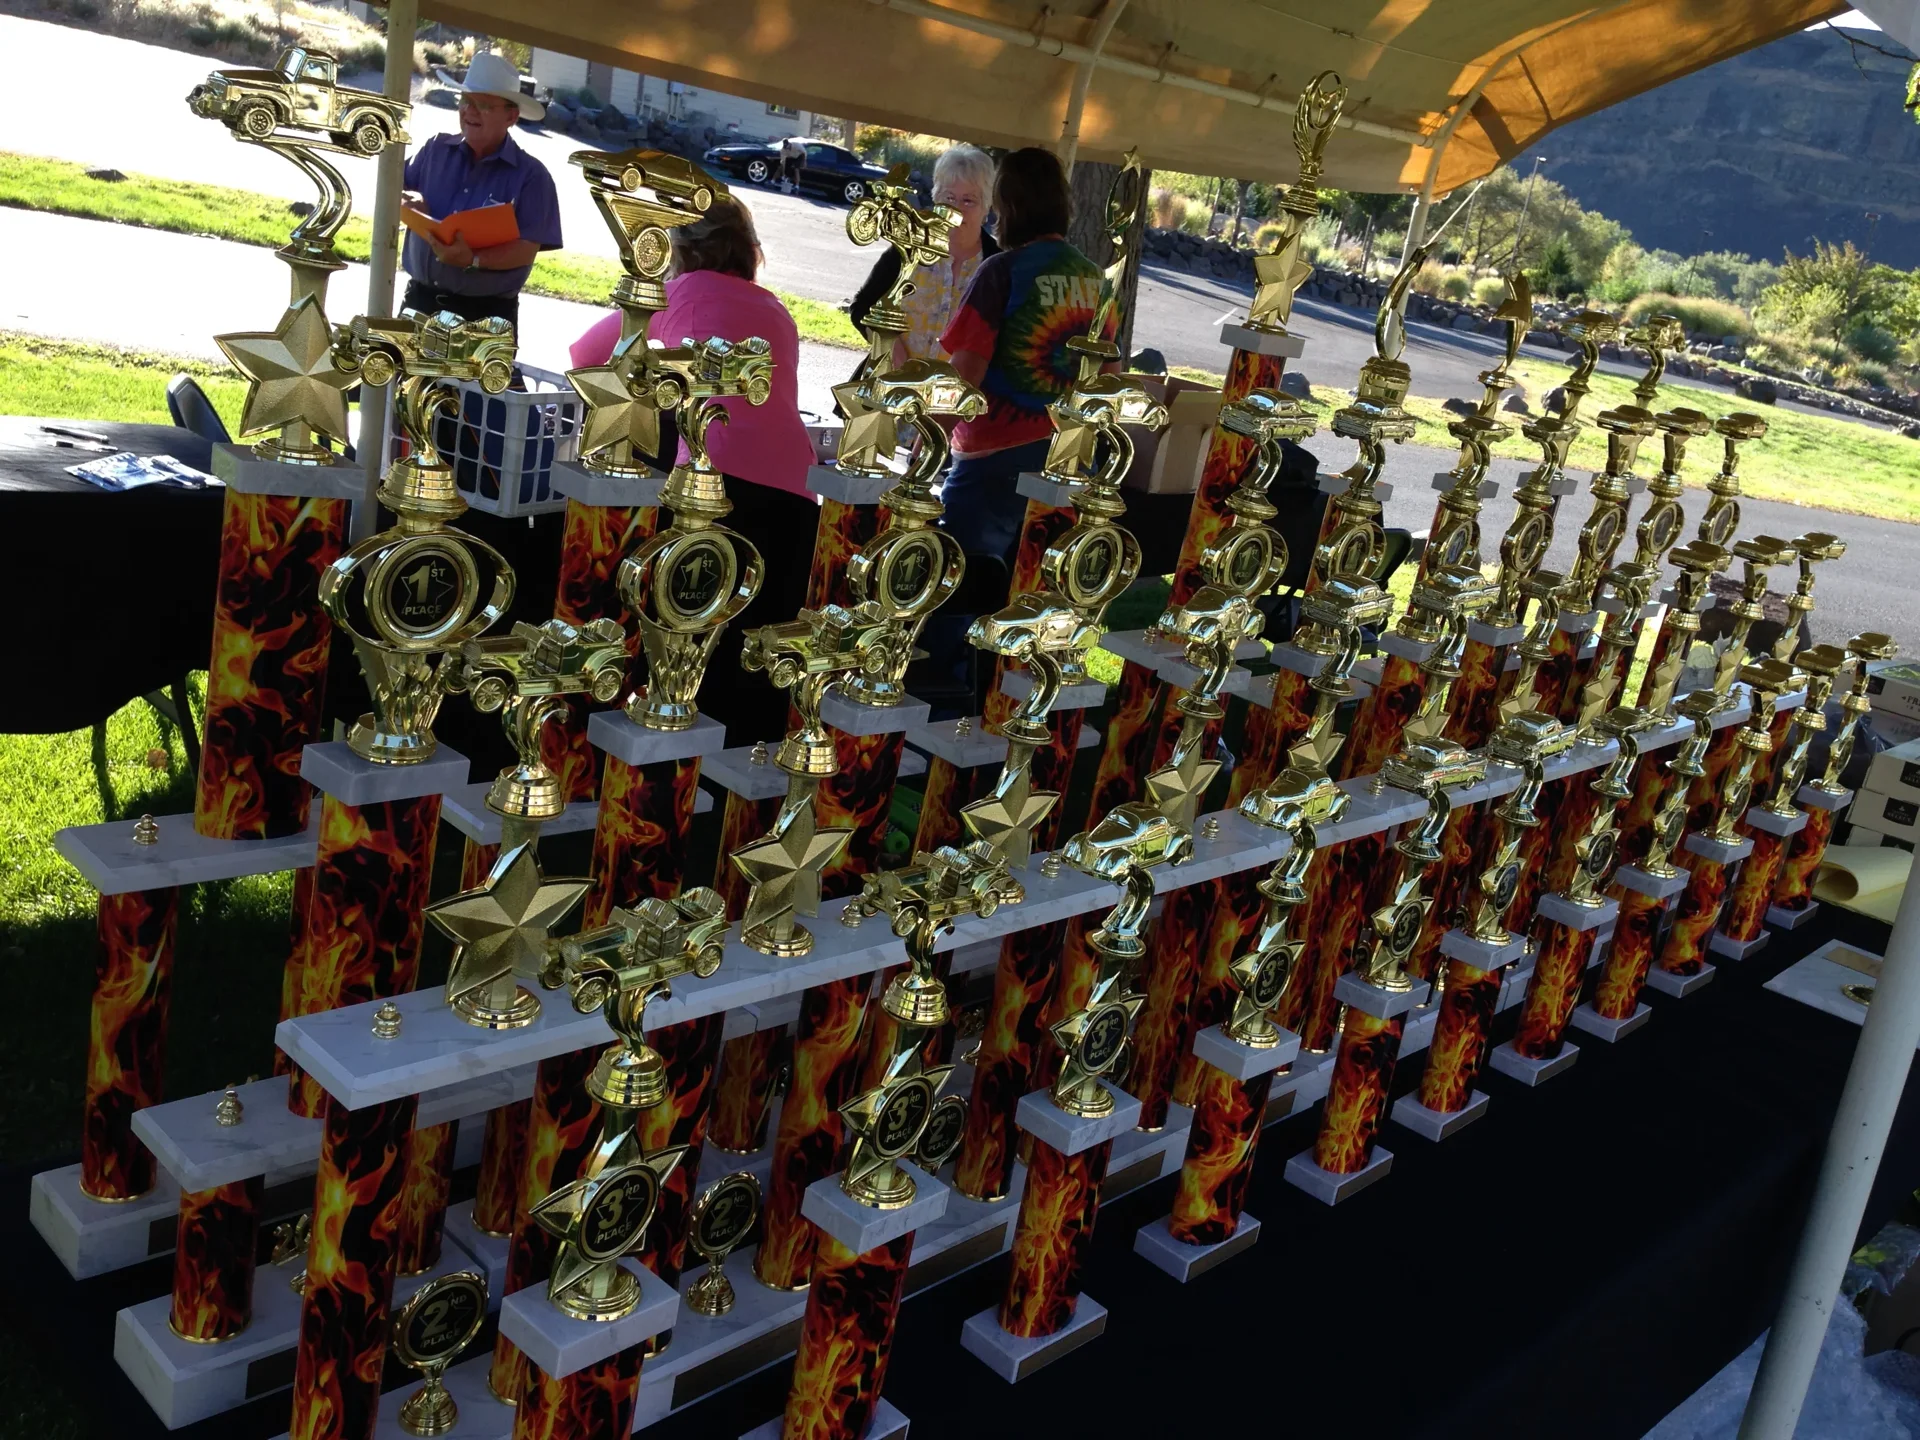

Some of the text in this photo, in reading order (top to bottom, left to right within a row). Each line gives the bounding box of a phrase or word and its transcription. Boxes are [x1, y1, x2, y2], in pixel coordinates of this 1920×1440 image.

[1035, 275, 1105, 309] STAF
[686, 557, 714, 589] 1ST
[903, 553, 925, 582] 1ST
[409, 565, 446, 603] 1ST
[680, 591, 708, 600] PLACE
[405, 605, 442, 615] PLACE
[1092, 1017, 1119, 1049] 3RD
[888, 1094, 921, 1131] 3RD
[885, 1125, 912, 1142] PLACE
[598, 1183, 640, 1230] 3RD
[710, 1194, 746, 1231] 2ND
[596, 1221, 632, 1244] PLACE
[421, 1294, 467, 1339] 2ND
[422, 1329, 460, 1347] PLACE
